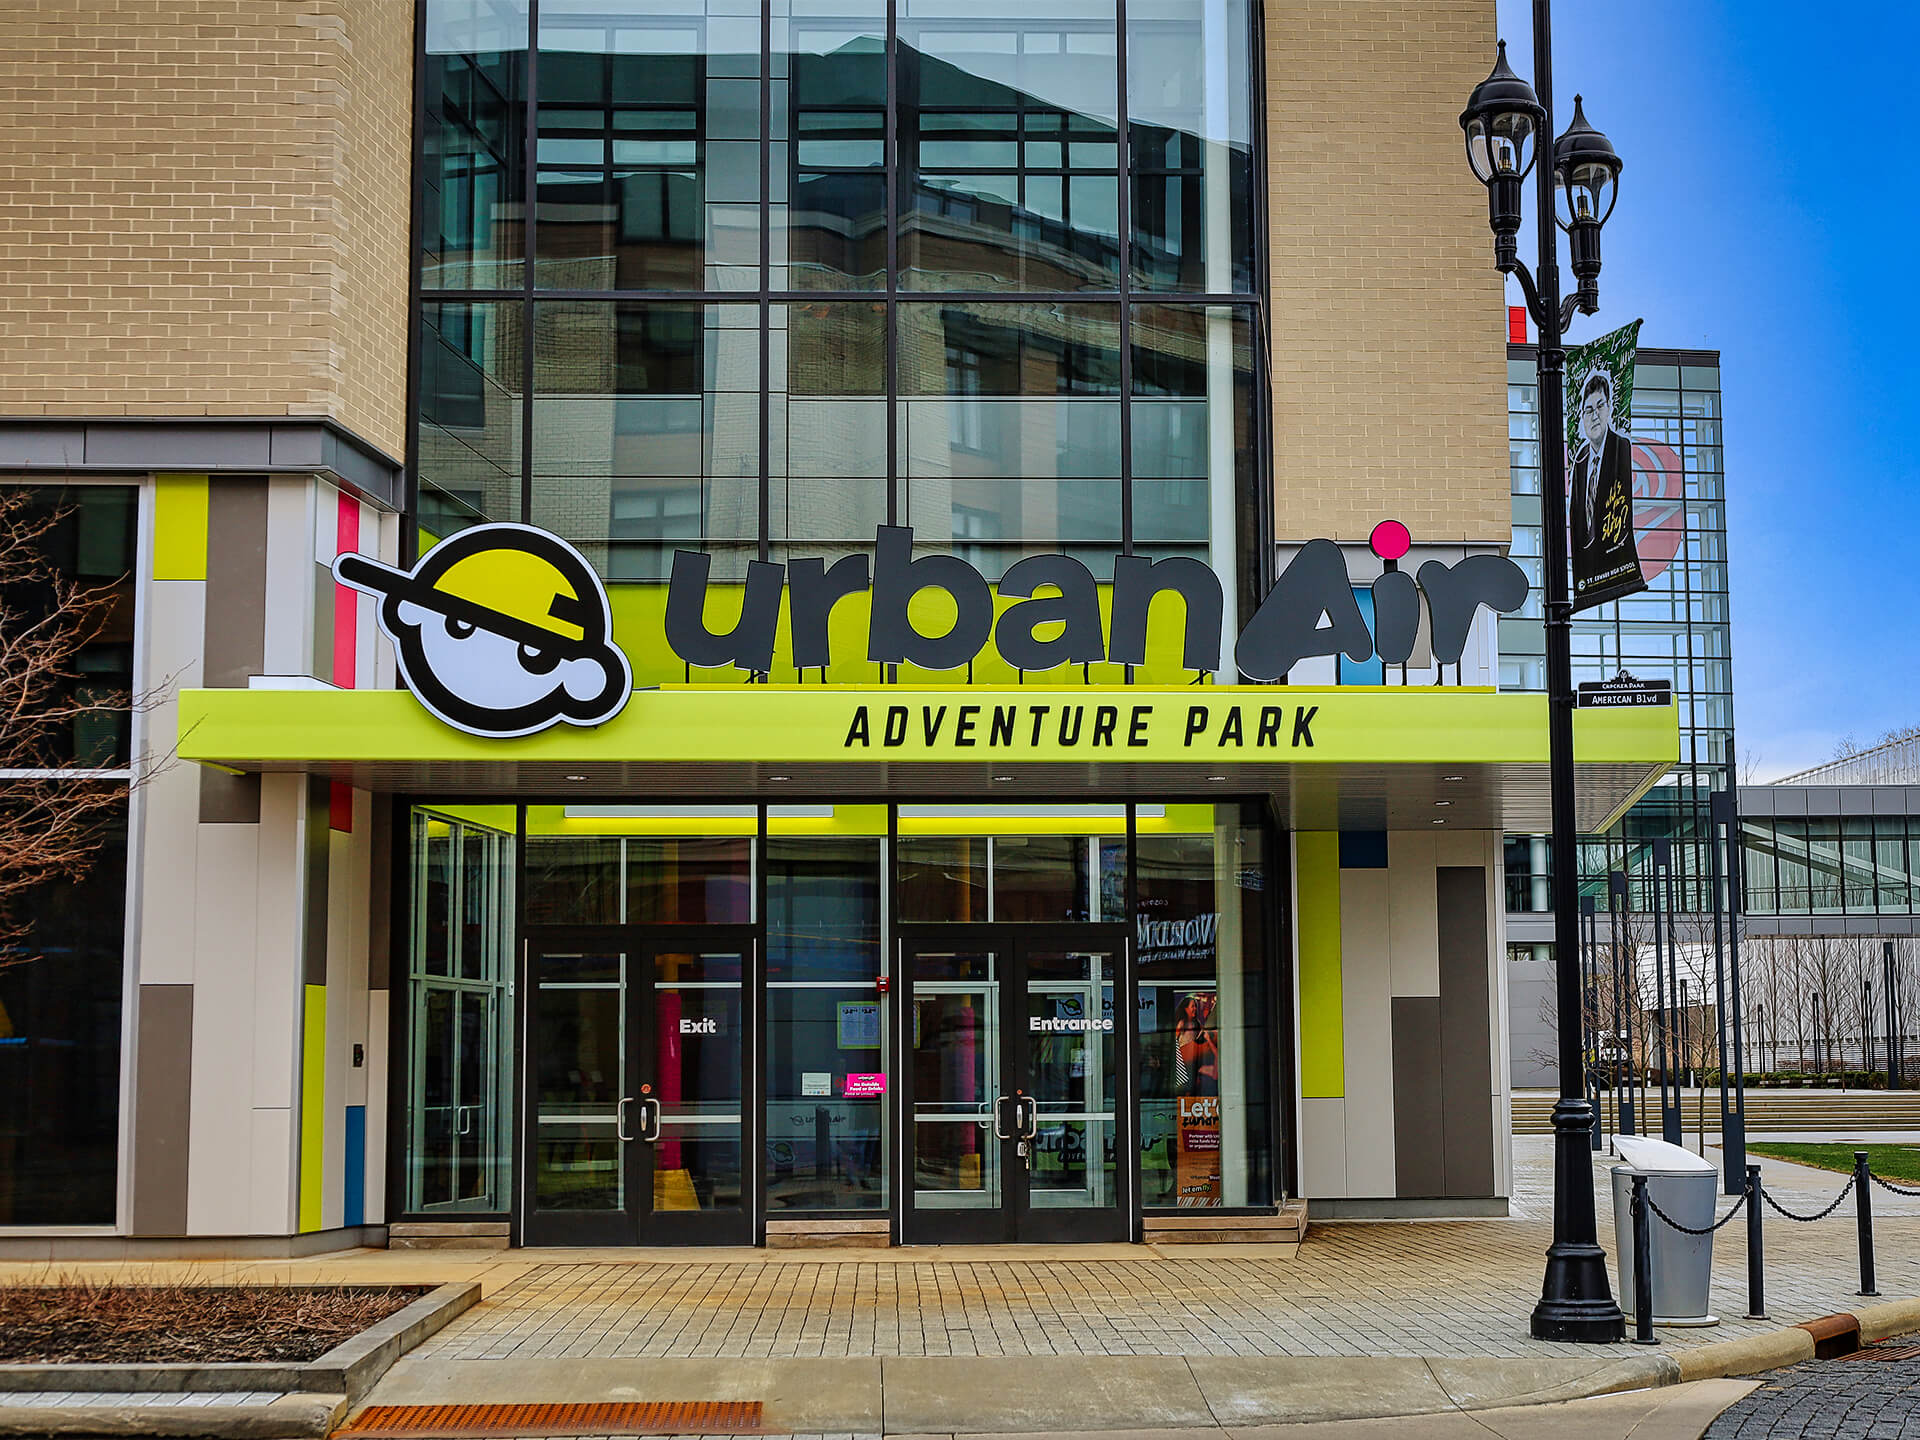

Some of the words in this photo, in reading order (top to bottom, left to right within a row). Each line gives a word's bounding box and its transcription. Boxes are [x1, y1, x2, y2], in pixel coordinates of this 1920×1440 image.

[663, 526, 1224, 673] urban
[1236, 520, 1529, 682] Air
[1591, 695, 1632, 704] AMERICAN
[1636, 694, 1657, 703] Blvd
[844, 704, 1153, 748] ADVENTURE
[1183, 704, 1321, 748] PARK
[679, 1017, 717, 1034] Exit
[1029, 1016, 1114, 1031] Entrance
